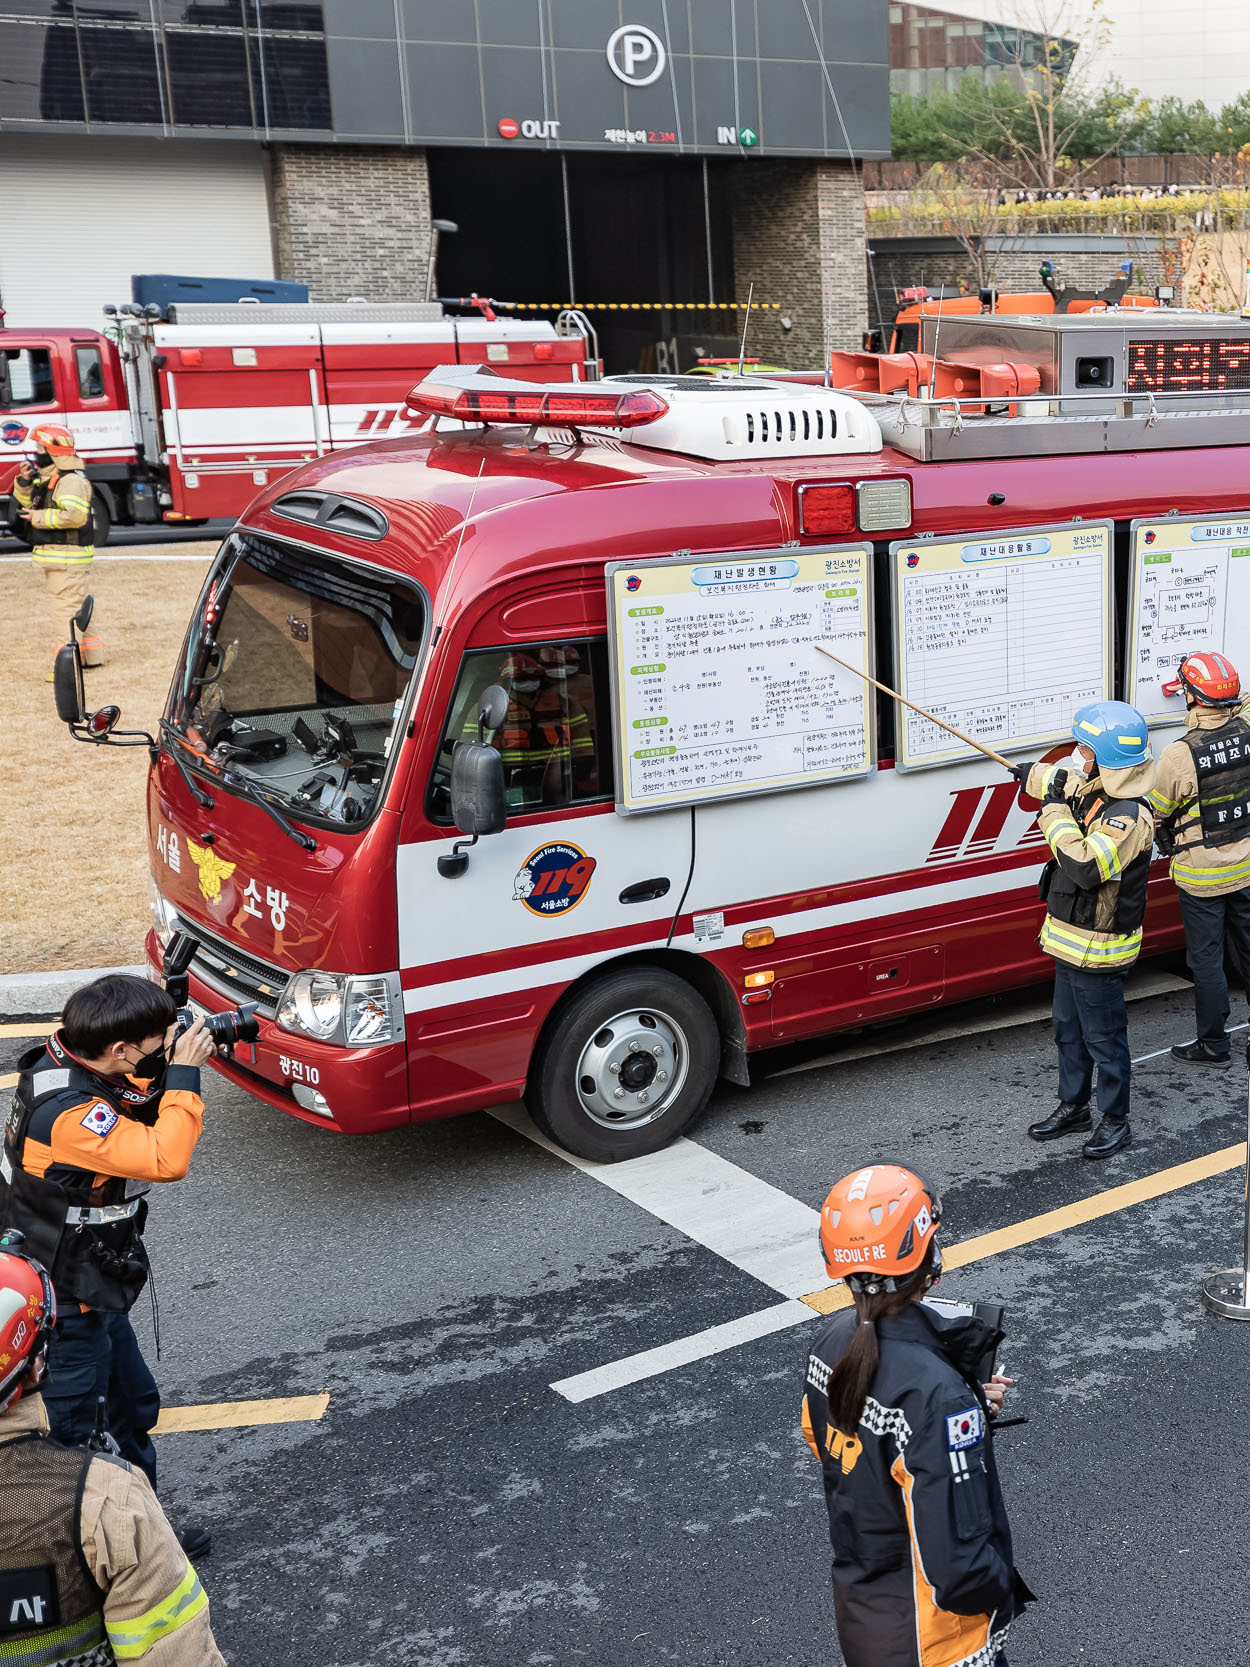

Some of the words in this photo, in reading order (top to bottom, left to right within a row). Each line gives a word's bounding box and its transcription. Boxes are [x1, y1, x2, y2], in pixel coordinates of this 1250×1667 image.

[623, 34, 653, 75] P
[521, 120, 560, 138] OUT
[604, 128, 647, 143] 제한높이
[648, 130, 675, 142] 2.3M
[717, 126, 736, 144] IN
[1073, 534, 1104, 546] 광진소방서
[1205, 527, 1232, 537] 재난대응
[979, 542, 1034, 556] 재난대응활동
[713, 565, 778, 581] 재난발생현황
[825, 558, 862, 571] 광진소방서
[637, 664, 660, 674] 피해상황
[1216, 681, 1238, 691] 화재조사
[1209, 736, 1241, 752] 서울소방
[529, 848, 545, 867] Seoul
[543, 846, 557, 856] Fire
[555, 845, 579, 859] Services
[156, 823, 182, 875] 서울
[243, 878, 290, 932] 소방
[530, 857, 597, 897] 119
[541, 897, 571, 911] 서울소방
[279, 1055, 320, 1085] 광진10
[101, 1115, 118, 1137] KOREA
[26, 1294, 39, 1318] 소방
[12, 1320, 27, 1350] 119
[9, 1595, 46, 1624] 사
